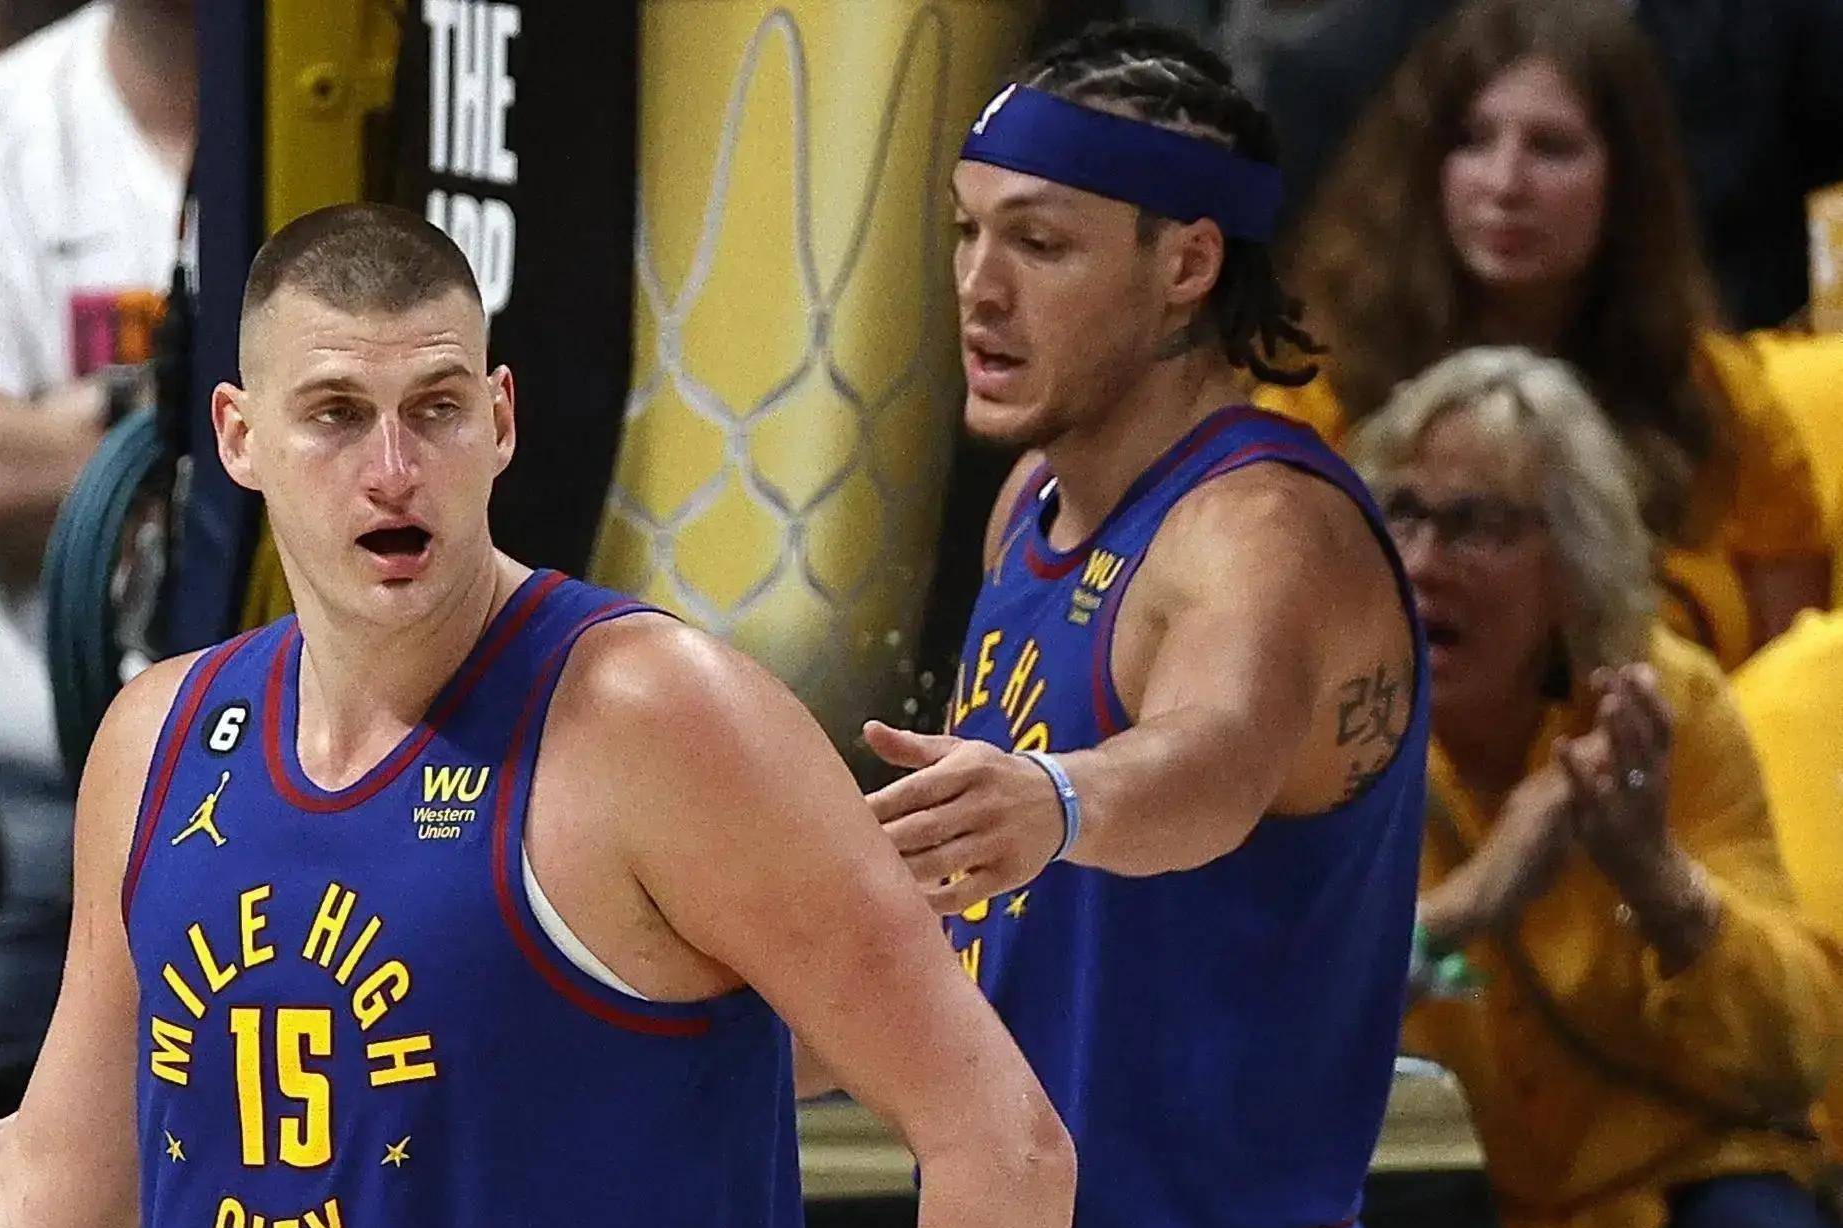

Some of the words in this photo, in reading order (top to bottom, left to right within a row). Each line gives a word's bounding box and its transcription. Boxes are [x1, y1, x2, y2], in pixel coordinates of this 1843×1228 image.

[422, 0, 522, 185] THE
[1082, 549, 1126, 592] WU
[209, 706, 245, 752] 6
[424, 766, 490, 802] WU
[413, 807, 476, 823] Western
[418, 823, 461, 840] Union
[150, 884, 276, 1086] MILE
[302, 882, 436, 1087] HIGH
[230, 1007, 332, 1167] 15
